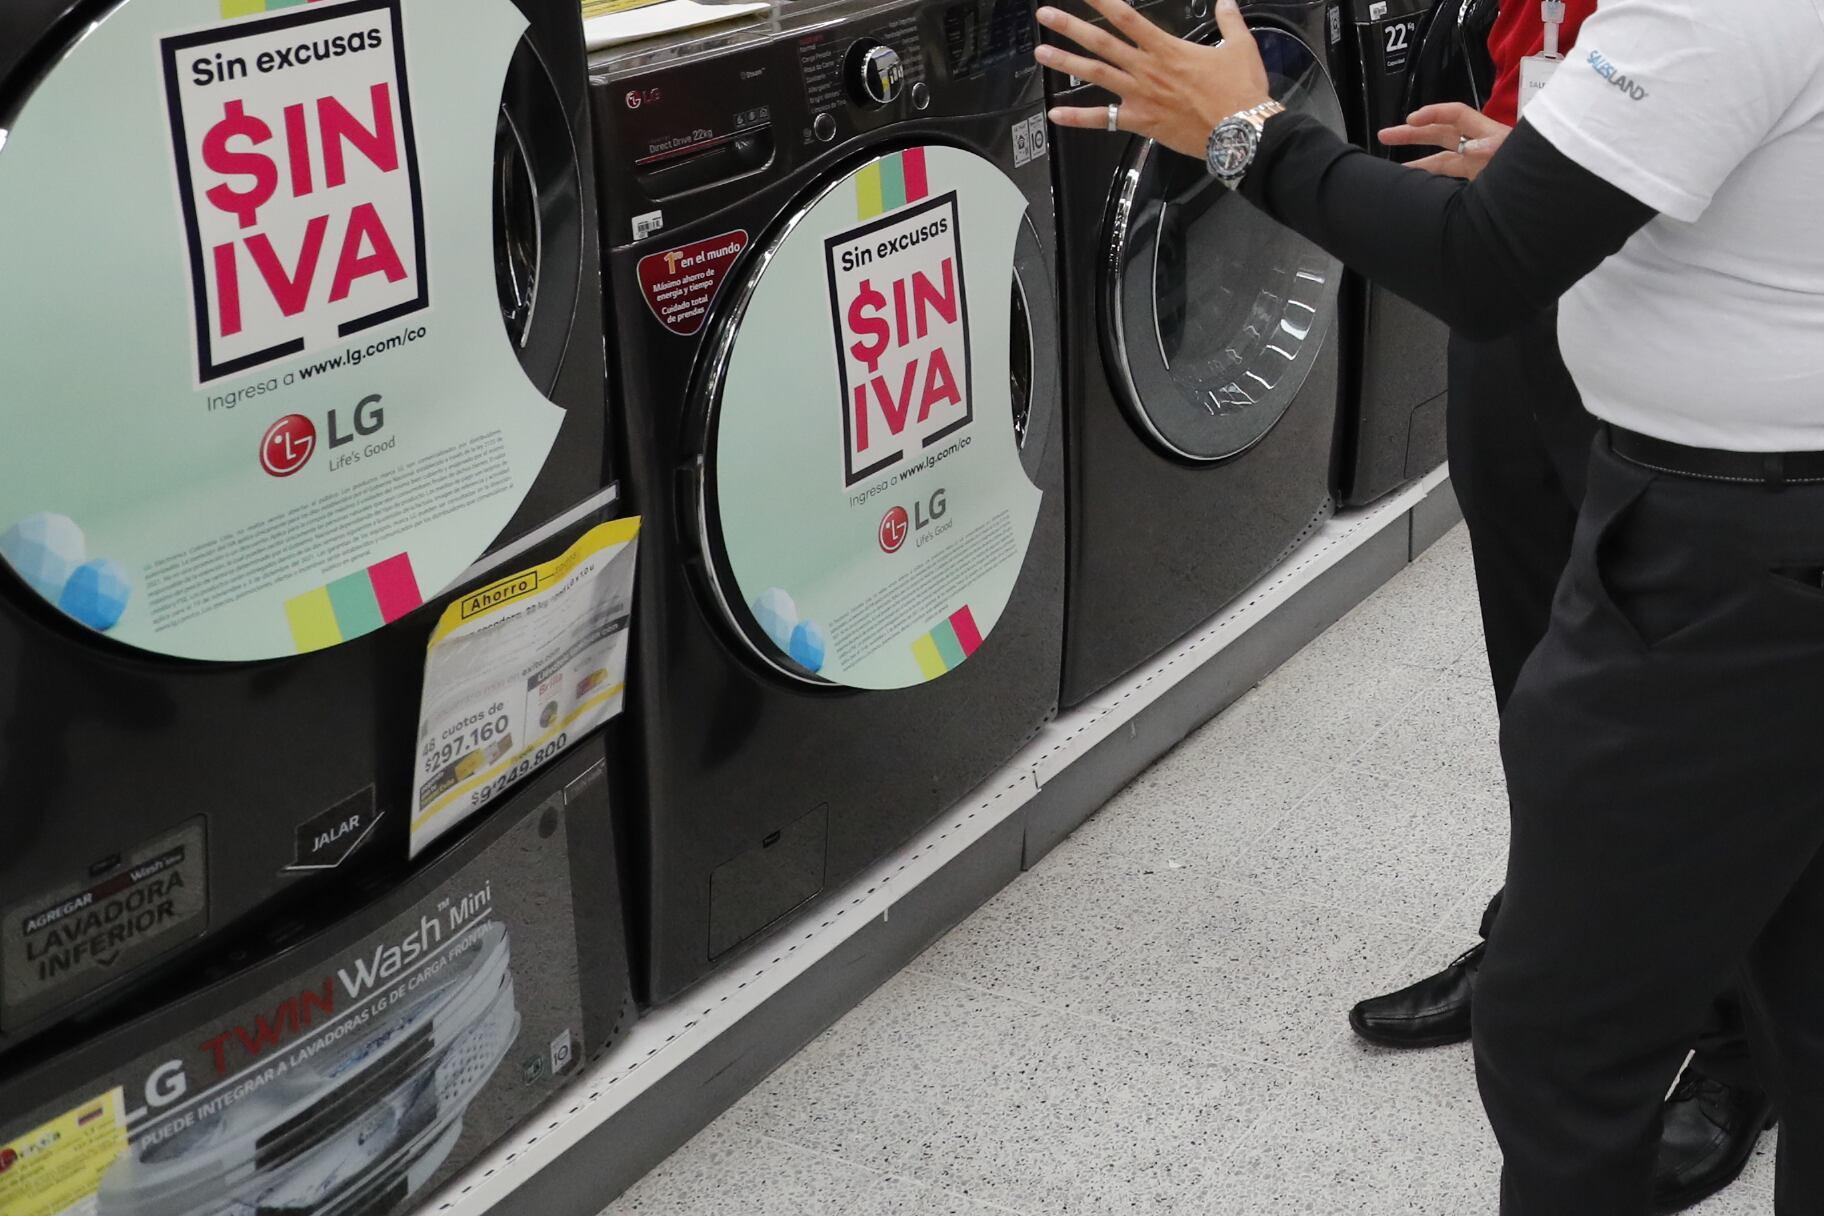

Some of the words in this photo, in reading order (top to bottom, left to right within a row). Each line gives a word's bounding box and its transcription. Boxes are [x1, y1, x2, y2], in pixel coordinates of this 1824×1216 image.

[192, 52, 247, 86] Sin
[256, 27, 383, 74] excusas
[1384, 23, 1408, 53] 22
[1586, 49, 1646, 101] SALESLAND
[201, 82, 399, 229] $IN
[649, 139, 673, 153] Direct
[672, 135, 692, 147] Drive
[1032, 128, 1045, 151] 10
[213, 202, 408, 338] IVA
[680, 257, 694, 269] en
[695, 250, 705, 264] el
[706, 241, 741, 261] mundo
[841, 249, 873, 273] Sin
[877, 216, 949, 260] excusas
[653, 278, 682, 293] Máximo
[681, 272, 705, 285] ahorro
[705, 268, 715, 277] de
[661, 300, 690, 315] Cuidado
[691, 294, 709, 306] total
[688, 278, 714, 292] tiempo
[667, 314, 677, 324] de
[677, 305, 705, 322] prendas
[845, 256, 958, 373] $IN
[206, 375, 279, 412] Ingresa
[283, 371, 295, 387] a
[299, 325, 427, 381] www.lg.com/co
[327, 393, 385, 450] LG
[852, 346, 962, 453] IVA
[328, 448, 362, 473] Life's
[363, 434, 397, 460] Good
[849, 481, 889, 509] Ingresa
[890, 475, 898, 487] a
[899, 436, 972, 481] www.lg.com/co
[914, 487, 947, 531] LG
[934, 518, 953, 536] Good
[469, 579, 529, 612] Ahorro
[424, 714, 509, 773] $297.160
[442, 707, 485, 740] cuotas
[487, 701, 505, 716] de
[471, 732, 568, 806] $9'249.800
[311, 814, 361, 852] JALAR
[26, 892, 93, 933] AGREGAR
[130, 861, 164, 881] Wash
[26, 870, 185, 962] LAVADORA
[38, 900, 176, 981] INFERIOR
[201, 975, 336, 1074] TWIN
[338, 915, 443, 999] Wash
[448, 880, 492, 931] Mini
[141, 1117, 194, 1152] PUEDE
[197, 1072, 275, 1120] INTEGRAR
[275, 1062, 288, 1080] A
[288, 1008, 371, 1069] LAVADORAS
[370, 996, 388, 1016] LG
[389, 987, 408, 1006] DE
[408, 956, 447, 994] CARGA
[448, 920, 494, 964] FRONTAL
